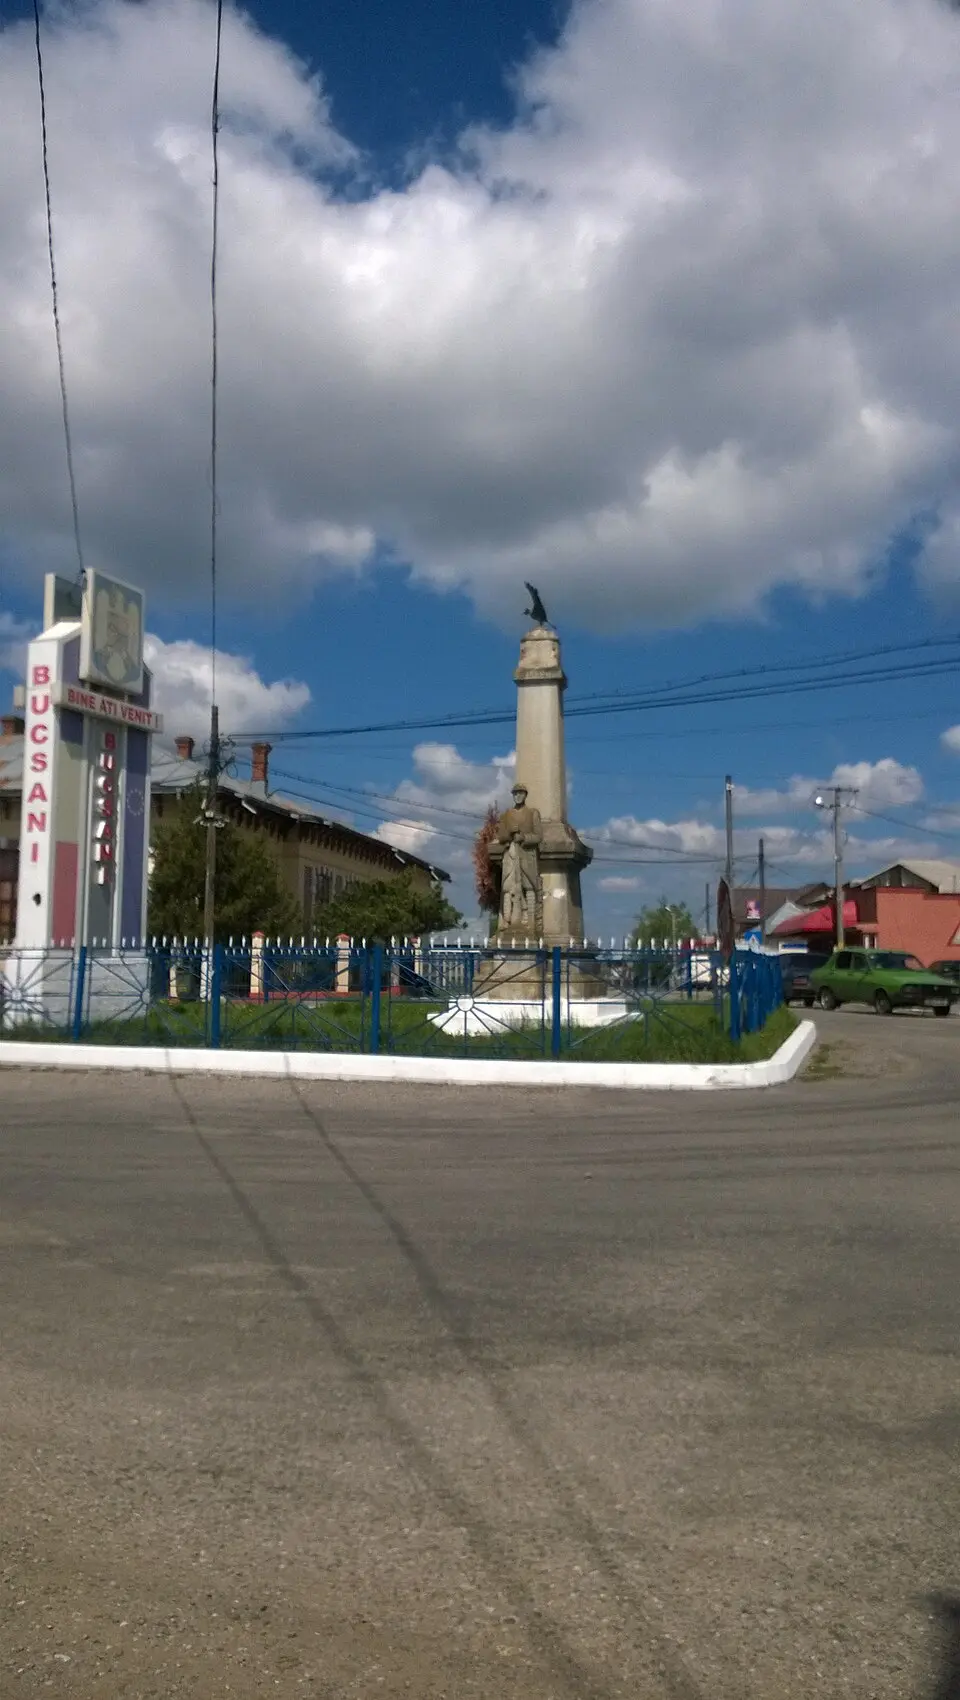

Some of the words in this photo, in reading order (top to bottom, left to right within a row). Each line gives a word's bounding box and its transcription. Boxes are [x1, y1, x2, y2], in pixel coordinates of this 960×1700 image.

[27, 665, 50, 863] BUCSANI
[67, 688, 96, 710] BINE
[100, 699, 117, 716] ATI
[120, 704, 152, 725] VENIT
[96, 732, 116, 884] BUCSANI
